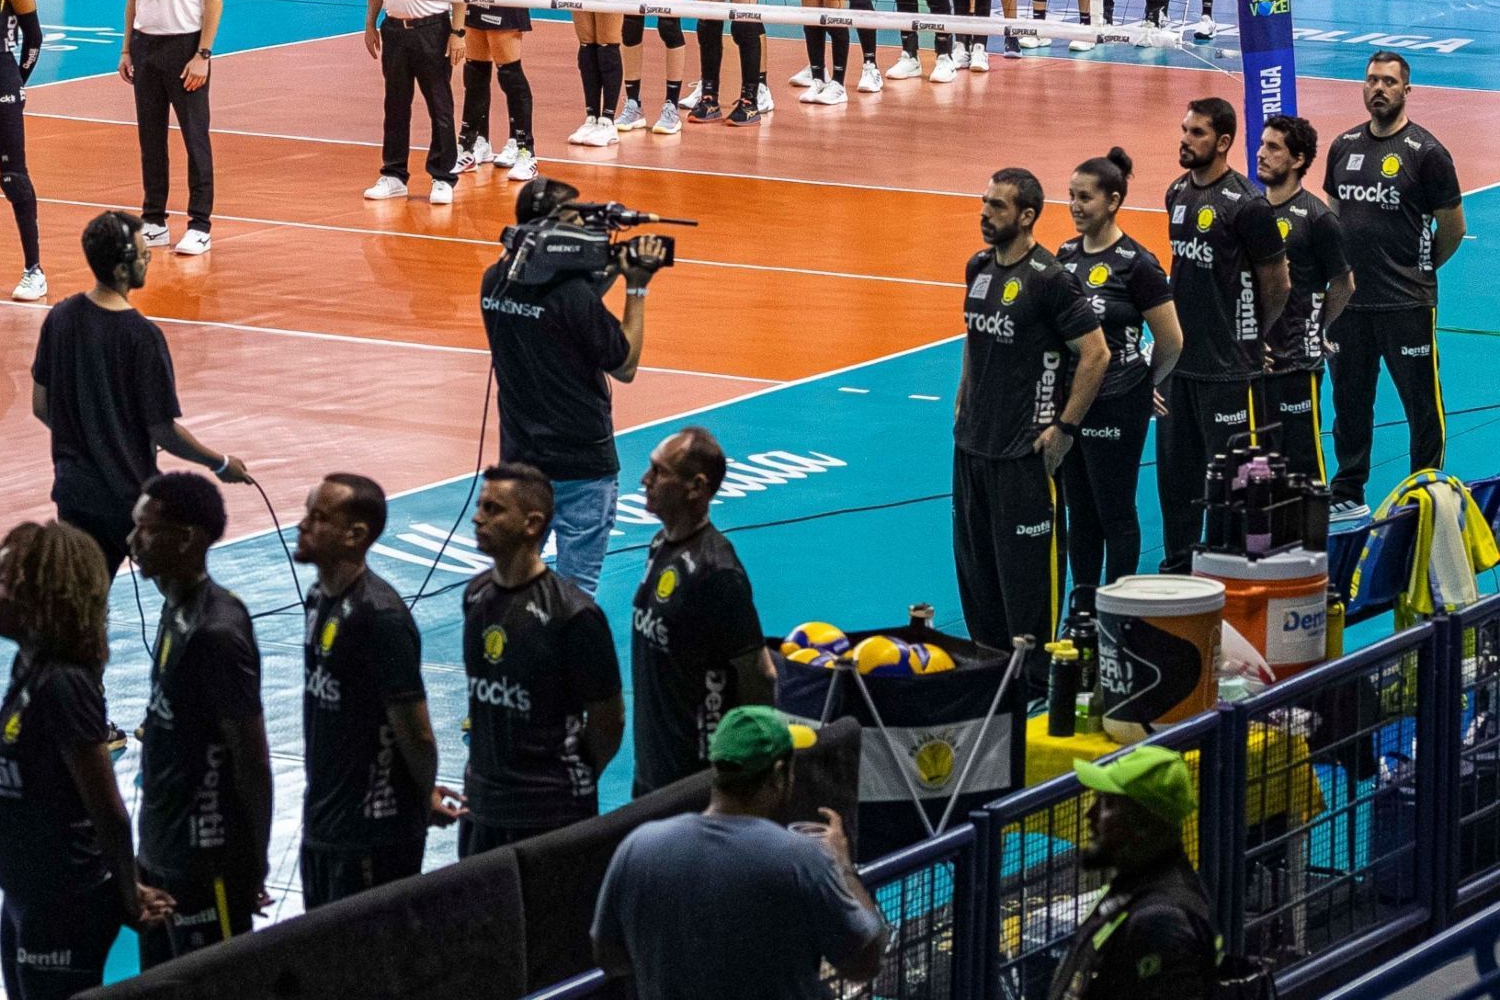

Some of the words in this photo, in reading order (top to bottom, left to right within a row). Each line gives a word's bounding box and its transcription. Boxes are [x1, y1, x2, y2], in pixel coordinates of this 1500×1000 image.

[558, 0, 582, 9] SUPERLIGA
[647, 6, 671, 14] SUPERLIGA
[736, 12, 761, 20] SUPERLIGA
[827, 16, 852, 25] SUPERLIGA
[919, 22, 944, 31] SUPERLIGA
[1010, 26, 1037, 36] SUPERLIGA
[1104, 34, 1130, 43] SUPERLIGA
[1260, 65, 1283, 122] ERLIGA
[1338, 181, 1401, 205] crock's
[1240, 271, 1258, 341] Dentil
[1400, 345, 1431, 358] Dentil
[1039, 351, 1060, 425] Dentil
[1279, 399, 1312, 413] Dentil
[1214, 409, 1248, 424] Dentil
[1081, 427, 1121, 438] crock's
[1016, 519, 1050, 534] Dentil
[171, 907, 218, 928] Dentil
[17, 947, 73, 968] Dentil
